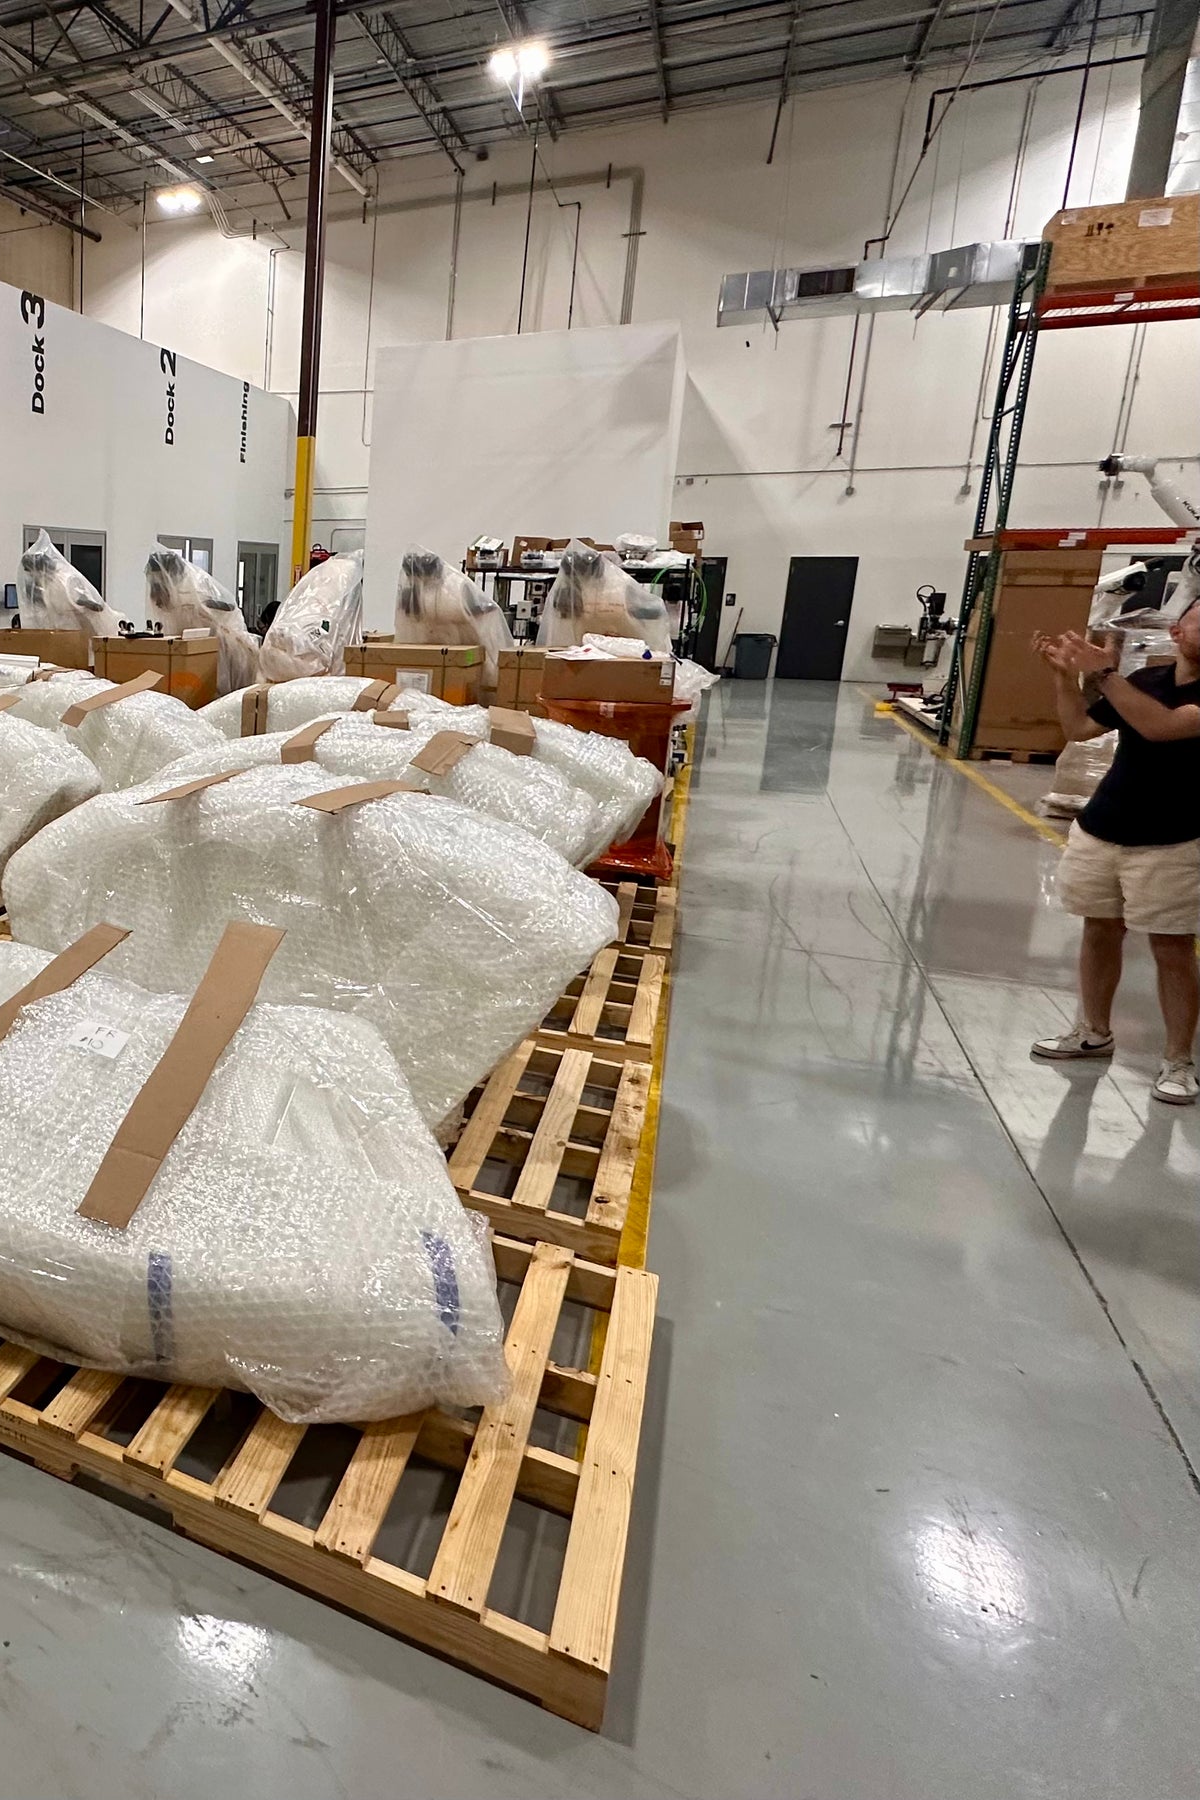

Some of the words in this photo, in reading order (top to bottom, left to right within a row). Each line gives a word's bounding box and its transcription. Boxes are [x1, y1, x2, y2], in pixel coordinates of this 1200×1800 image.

[20, 290, 45, 329] 3
[31, 334, 45, 415] Dock
[160, 348, 177, 377] 2
[165, 381, 176, 445] Dock
[240, 381, 250, 464] Finishing
